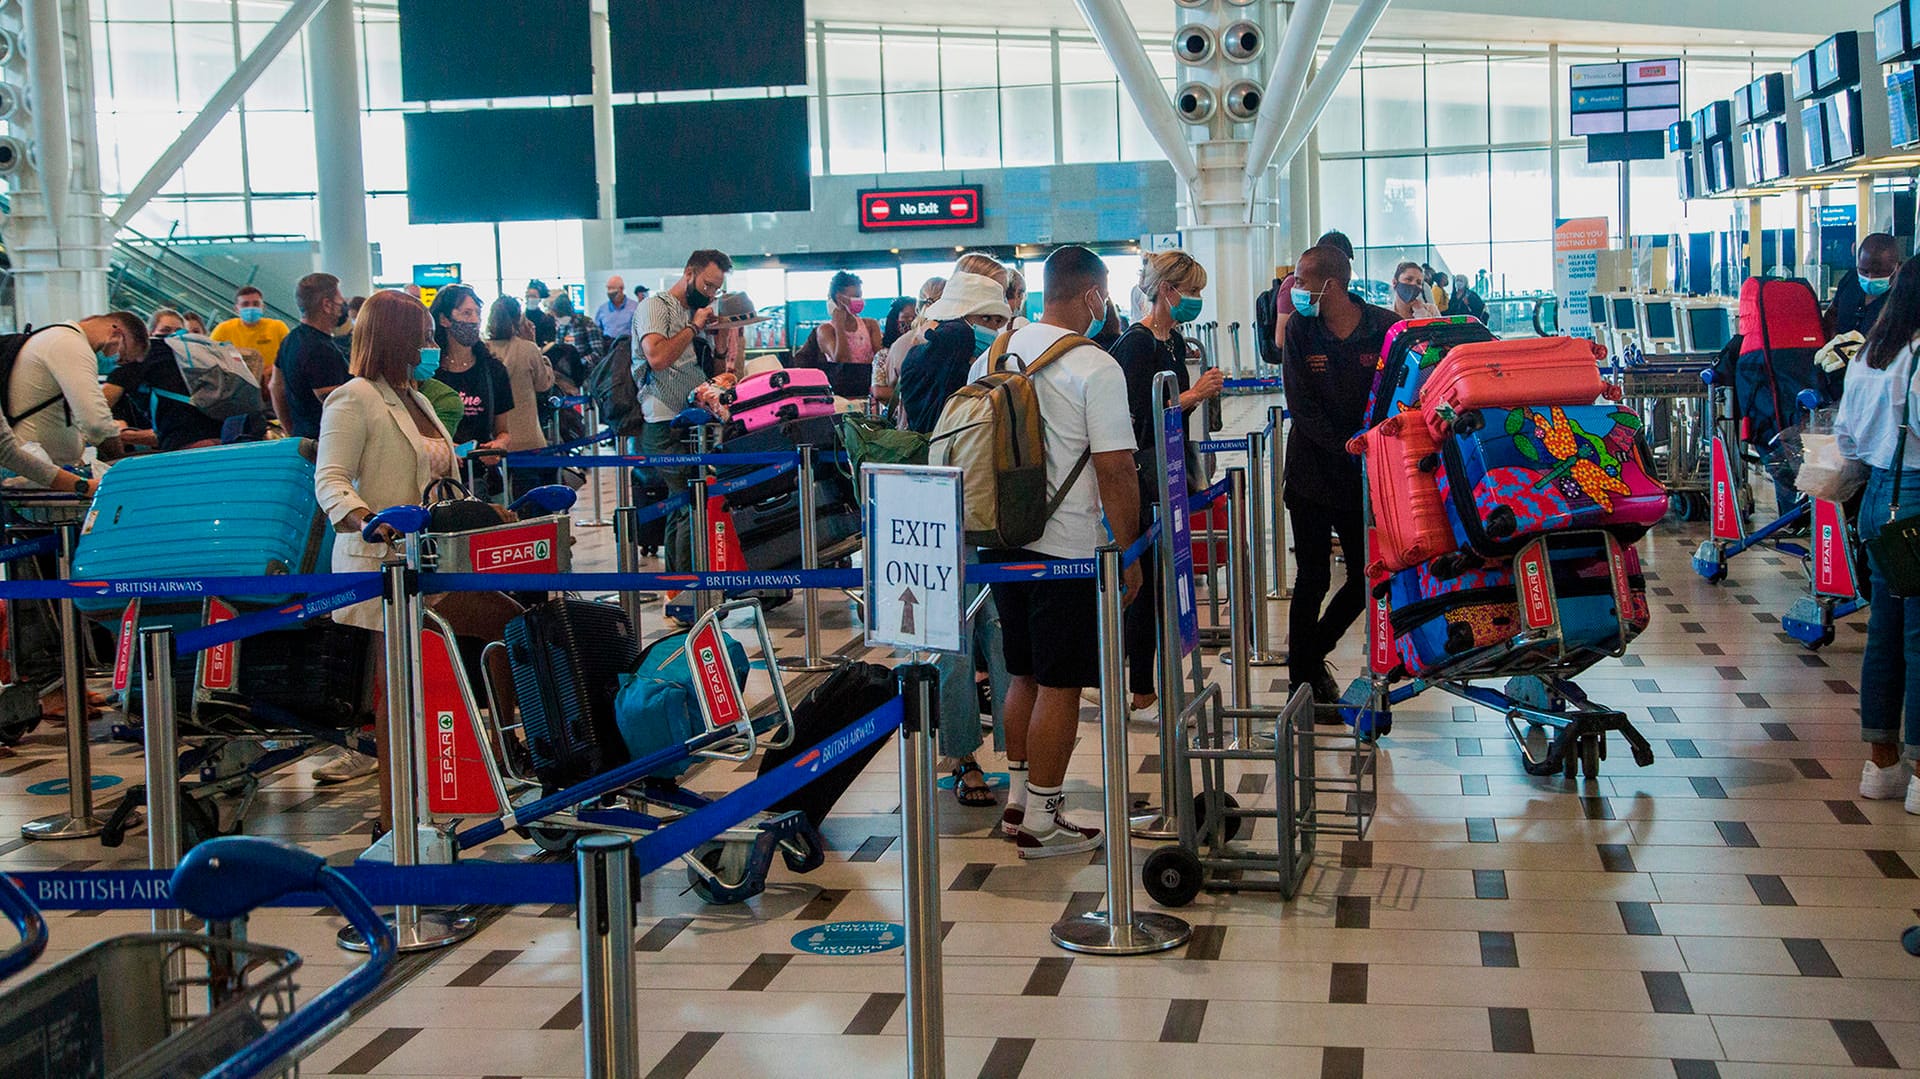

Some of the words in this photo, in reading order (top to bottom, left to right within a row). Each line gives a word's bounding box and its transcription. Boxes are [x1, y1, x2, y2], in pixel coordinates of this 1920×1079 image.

[900, 203, 917, 215] No
[918, 202, 939, 214] Exit
[675, 455, 702, 463] AIRWAYS
[717, 534, 725, 562] SPAR
[890, 519, 946, 549] EXIT
[491, 546, 534, 565] SPAR
[1823, 538, 1831, 573] SPAR
[115, 582, 158, 593] BRITISH
[160, 580, 204, 592] AIRWAYS
[706, 575, 751, 587] BRITISH
[753, 574, 801, 586] AIRWAYS
[886, 560, 952, 592] ONLY
[306, 598, 332, 614] BRITISH
[331, 590, 357, 608] AIRWAYS
[1530, 575, 1543, 610] SPAR
[1379, 611, 1387, 650] SPAR
[120, 637, 131, 672] SPAR
[213, 643, 225, 670] SPA
[708, 662, 727, 704] SPAR
[822, 737, 850, 764] BRITISH
[849, 718, 876, 750] AIRWAYS
[442, 732, 454, 784] SPAR
[38, 880, 125, 900] BRITISH
[131, 879, 172, 899] AIR
